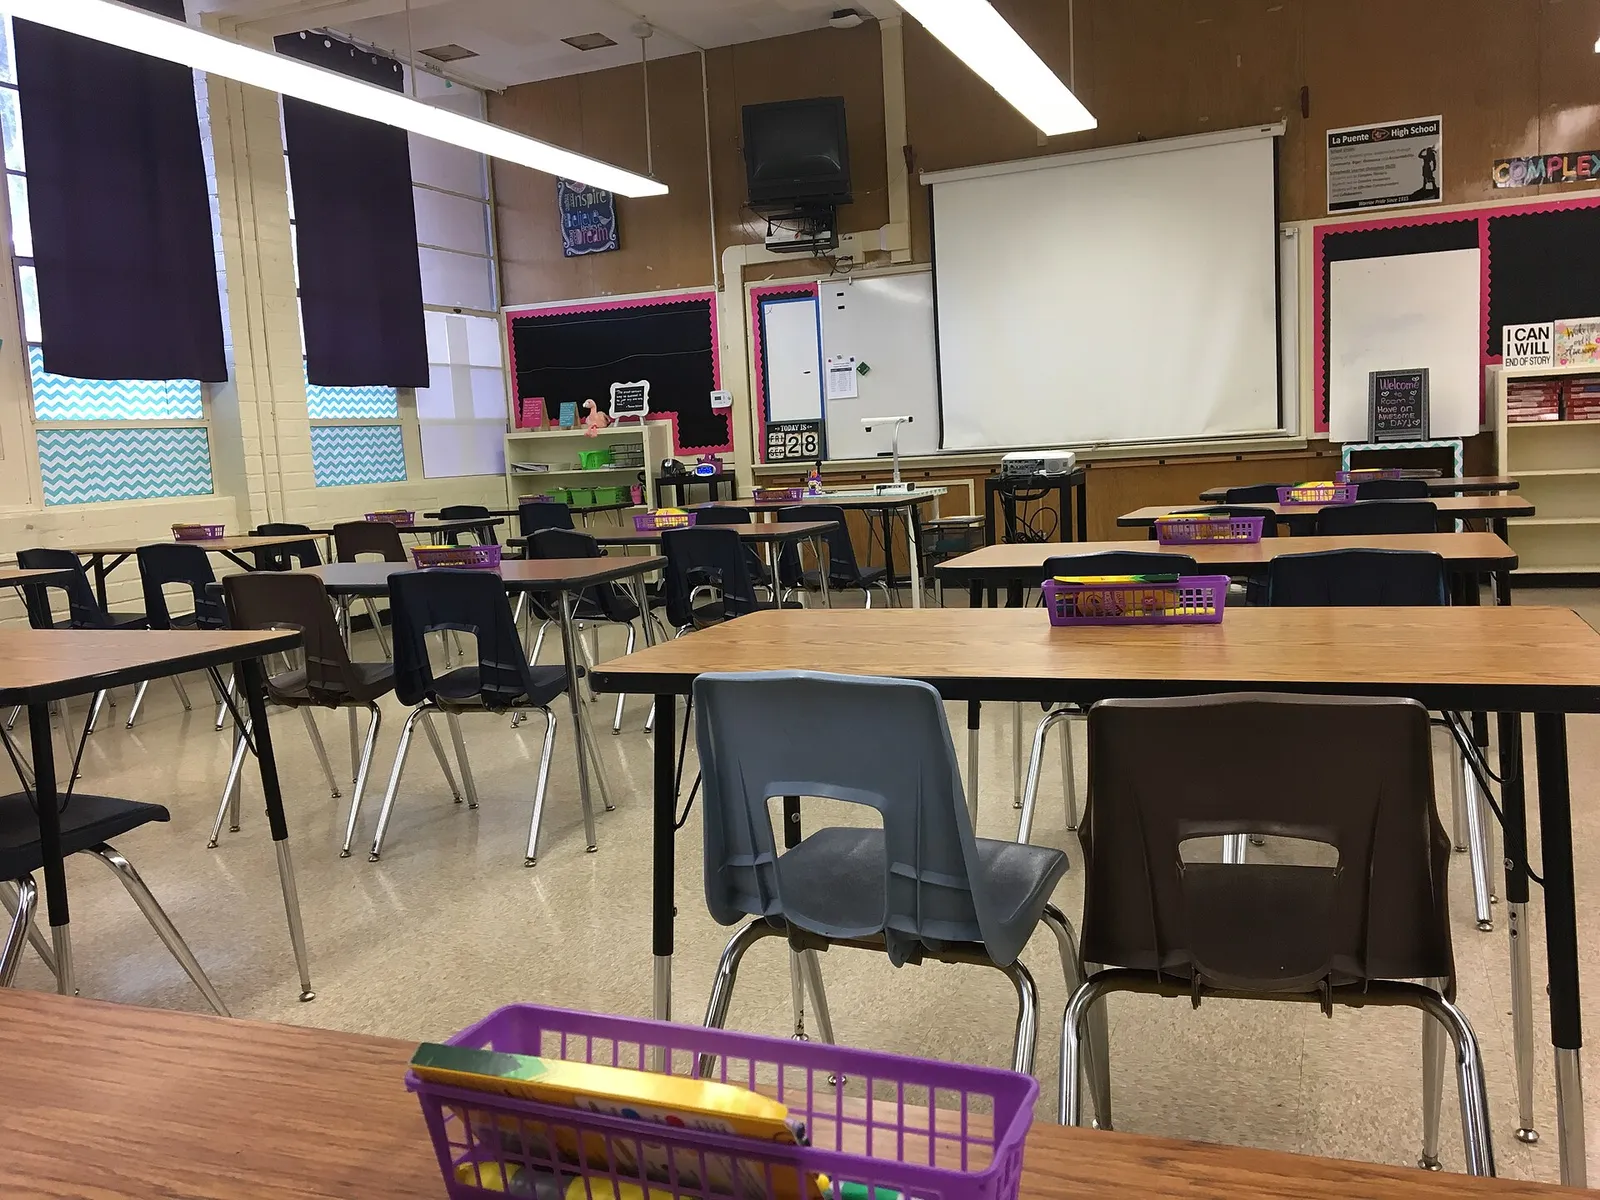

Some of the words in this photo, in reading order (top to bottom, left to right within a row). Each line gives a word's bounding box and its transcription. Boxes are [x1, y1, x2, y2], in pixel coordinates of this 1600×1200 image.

[1332, 136, 1341, 145] La
[1342, 133, 1370, 144] Puente
[1391, 127, 1409, 138] High
[1410, 123, 1437, 134] School
[1507, 329, 1511, 342] I
[1515, 326, 1550, 342] CAN
[1507, 343, 1511, 357] I
[1515, 341, 1550, 356] WILL
[1505, 358, 1519, 367] END
[1520, 357, 1529, 366] OF
[1529, 356, 1551, 365] STORY
[1380, 377, 1420, 390] Welcome
[1380, 397, 1406, 405] Room
[1408, 395, 1416, 405] 5
[1400, 405, 1413, 413] an
[780, 424, 800, 432] TODAY
[800, 423, 807, 431] IS
[770, 434, 784, 443] FRI
[770, 448, 784, 457] SEP
